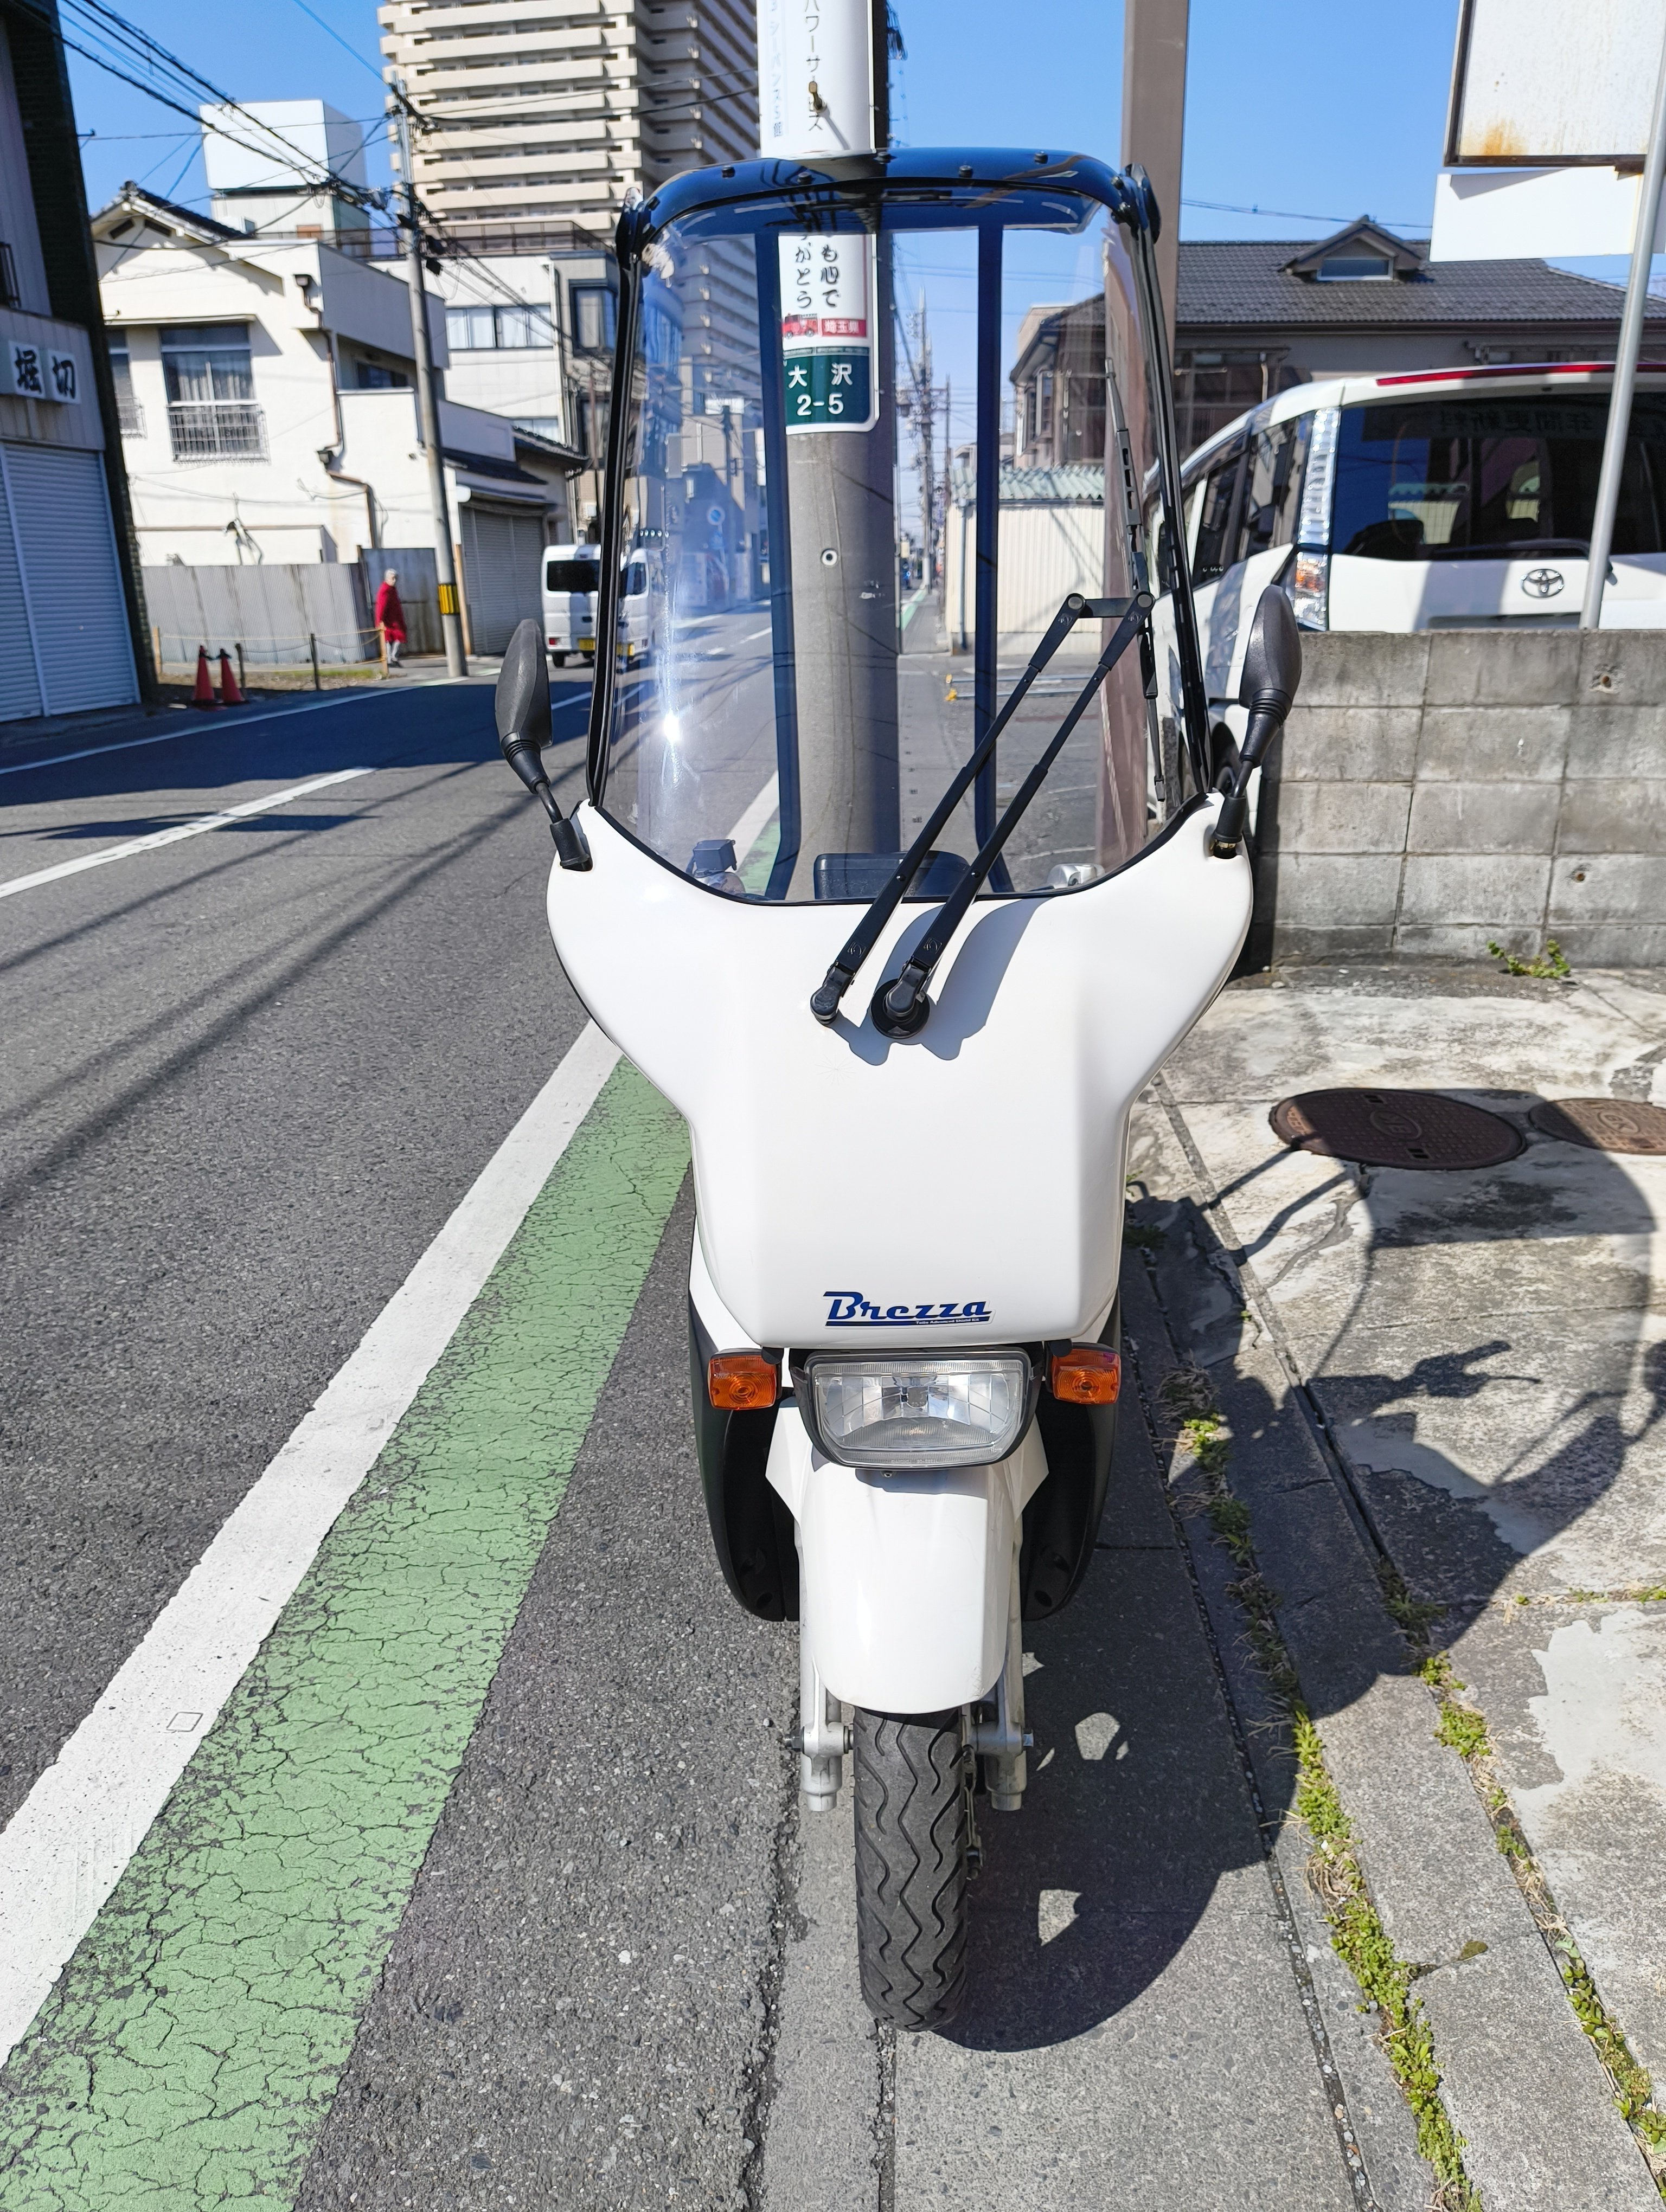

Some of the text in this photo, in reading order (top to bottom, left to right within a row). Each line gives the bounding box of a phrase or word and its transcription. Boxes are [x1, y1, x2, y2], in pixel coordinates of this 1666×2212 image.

[824, 319, 860, 333] 埼玉県
[14, 346, 76, 400] 堀切
[797, 393, 844, 416] 2-5
[823, 1291, 992, 1320] Brezza
